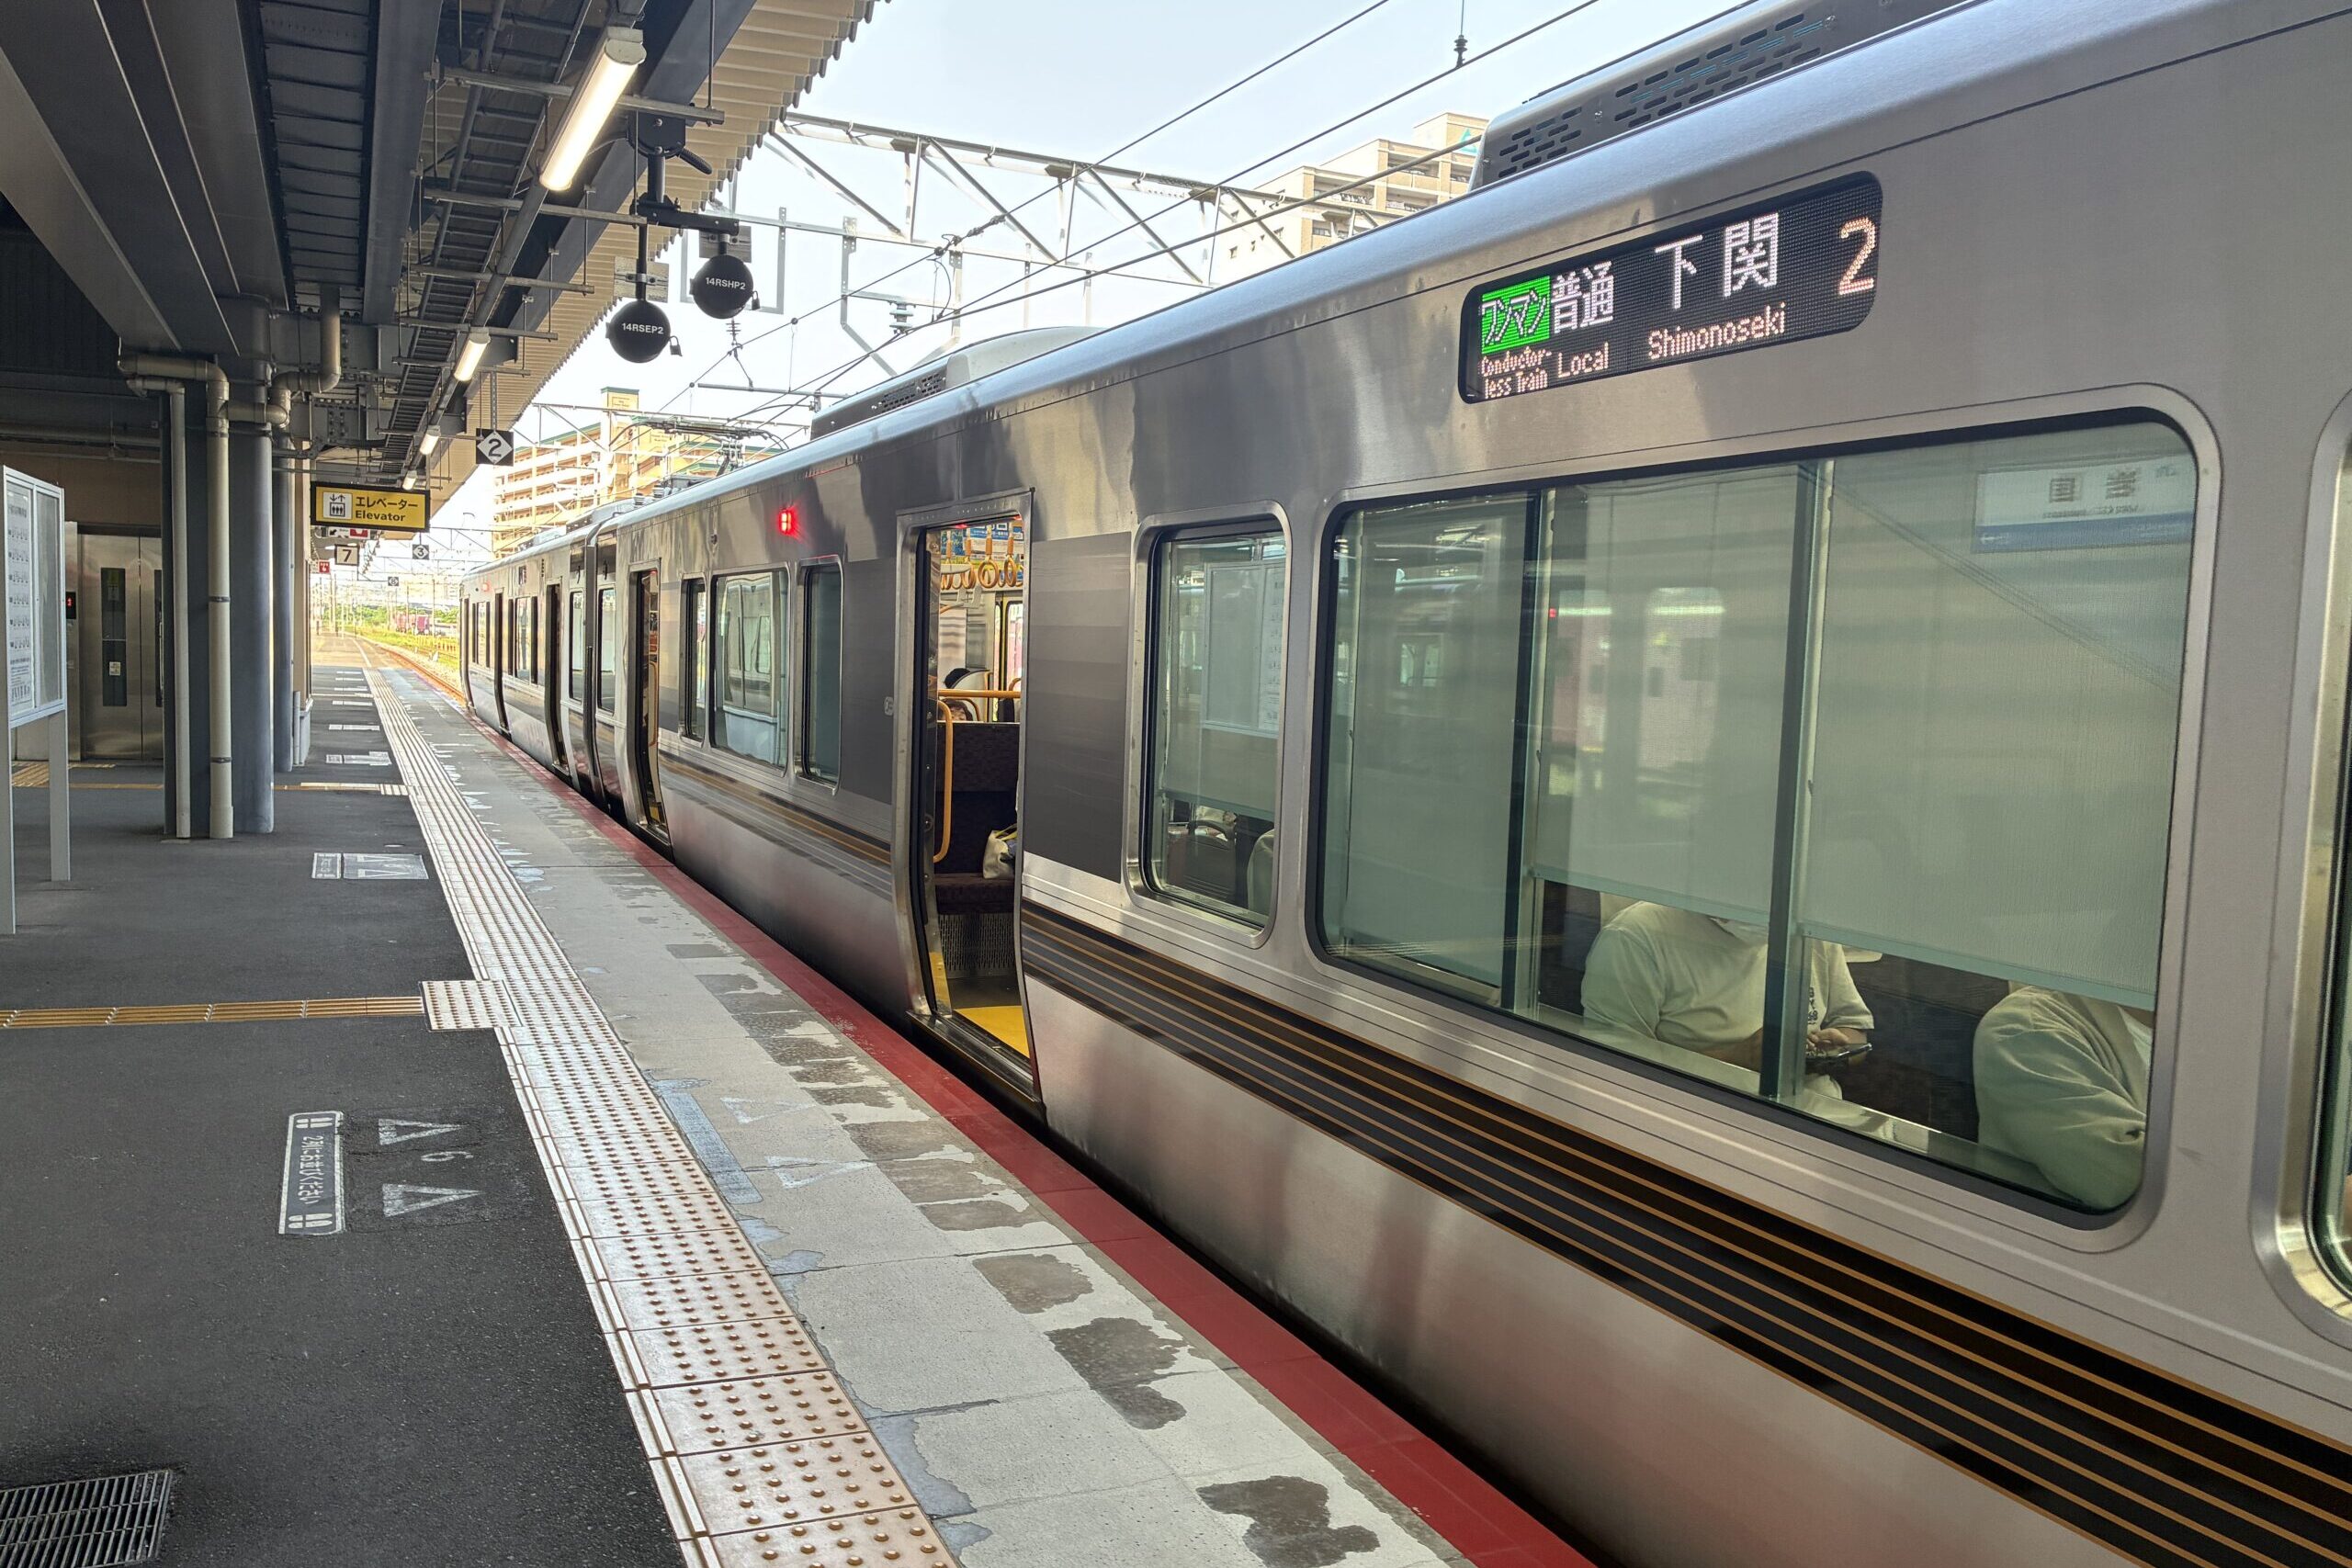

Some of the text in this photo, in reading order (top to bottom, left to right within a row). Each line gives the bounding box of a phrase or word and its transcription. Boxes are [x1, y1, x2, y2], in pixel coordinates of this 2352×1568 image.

[1551, 260, 1614, 334] 普通
[1655, 212, 1780, 310] 下関
[1838, 216, 1876, 295] 2
[705, 276, 746, 290] 14RSHP2
[622, 322, 664, 335] 14RSEP2
[1648, 301, 1786, 359] Shimonoseki
[1481, 346, 1553, 378] Conductor-
[1558, 342, 1609, 378] Local
[1485, 367, 1548, 400] less Train
[488, 438, 502, 457] 2
[355, 496, 418, 510] エレベーター
[355, 510, 406, 522] Elevator
[343, 548, 352, 562] 7
